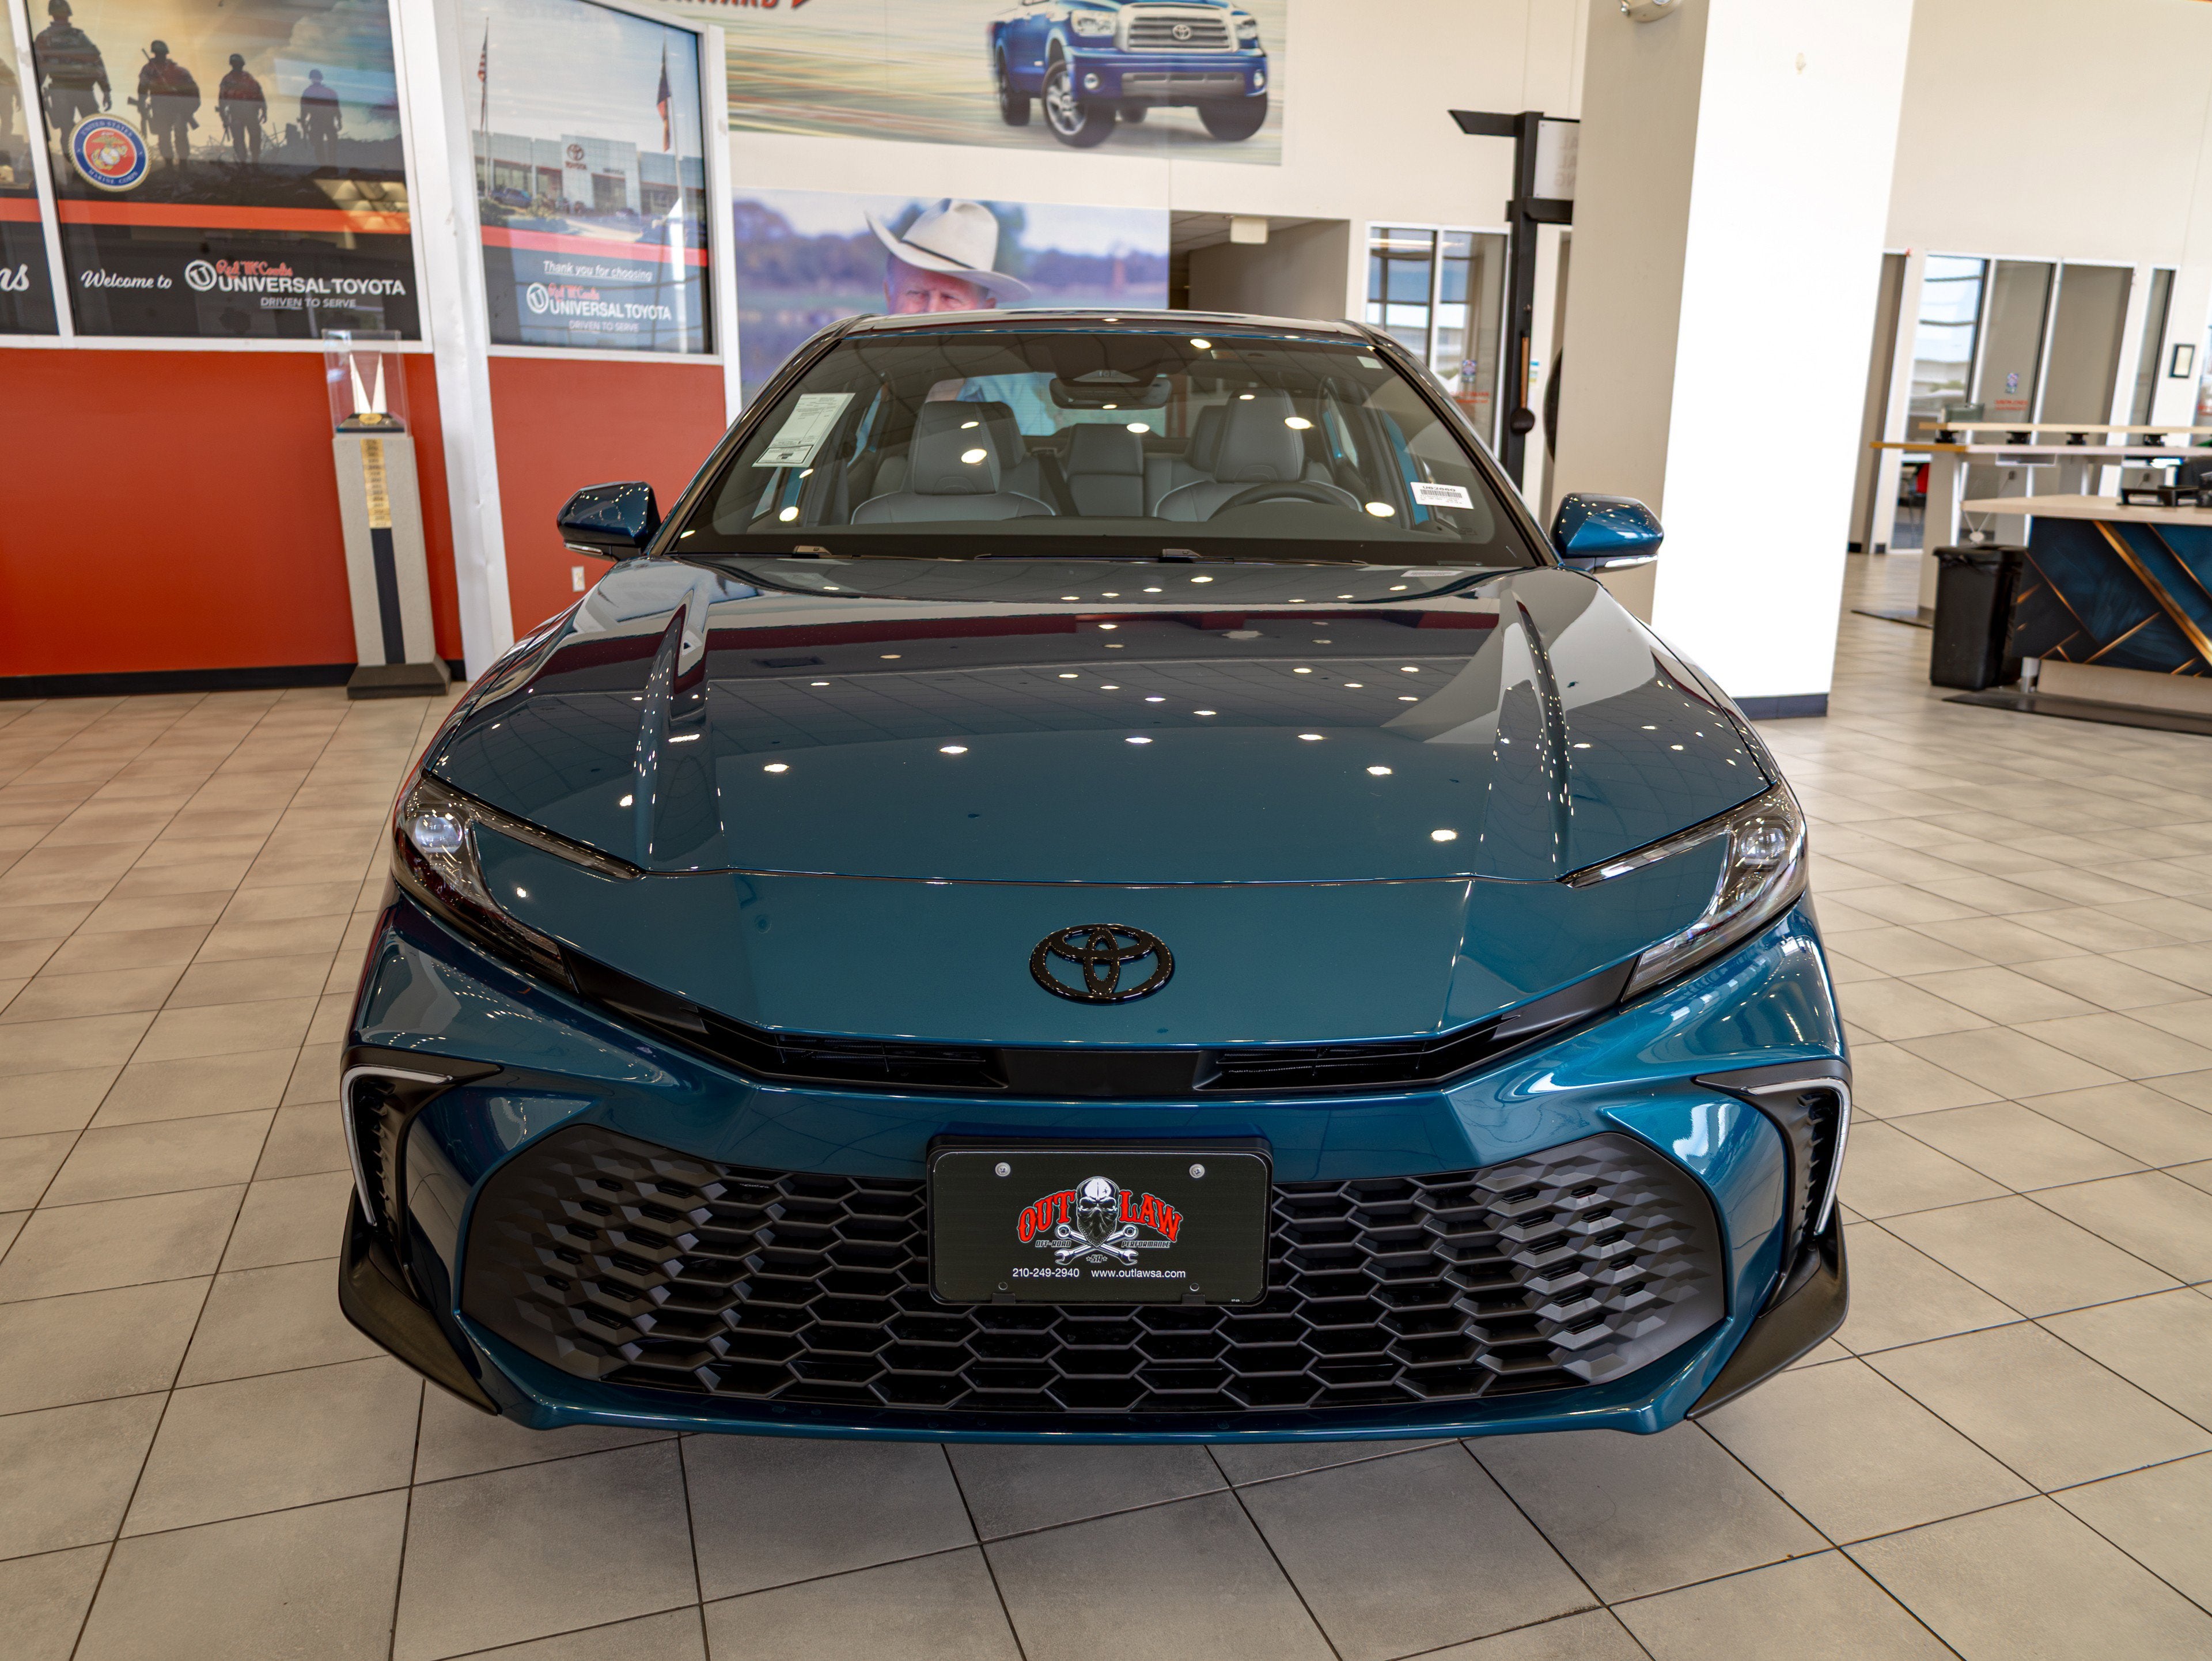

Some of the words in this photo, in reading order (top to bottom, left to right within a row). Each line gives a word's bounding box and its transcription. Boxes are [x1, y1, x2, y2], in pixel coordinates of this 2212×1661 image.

[80, 268, 154, 289] Welcome
[157, 274, 172, 289] to
[543, 260, 573, 274] Thank
[575, 266, 594, 277] you
[596, 264, 609, 277] for
[611, 268, 653, 282] choosing
[218, 275, 331, 294] UNIVERSAL
[332, 278, 406, 296] TOYOTA
[260, 297, 302, 308] DRIVEN
[305, 298, 320, 308] TO
[323, 298, 356, 309] SERVE
[550, 298, 624, 317] UNIVERSAL
[624, 303, 672, 320] TOYOTA
[569, 320, 600, 331] DRIVEN
[602, 321, 613, 331] TO
[615, 321, 639, 332] SERVE
[1035, 1239, 1072, 1248] OFF-ROAD
[1121, 1240, 1171, 1248] PERFORMANCE
[1012, 1268, 1080, 1277] 210-249-2940
[1091, 1269, 1186, 1278] www.outlawsa.com
